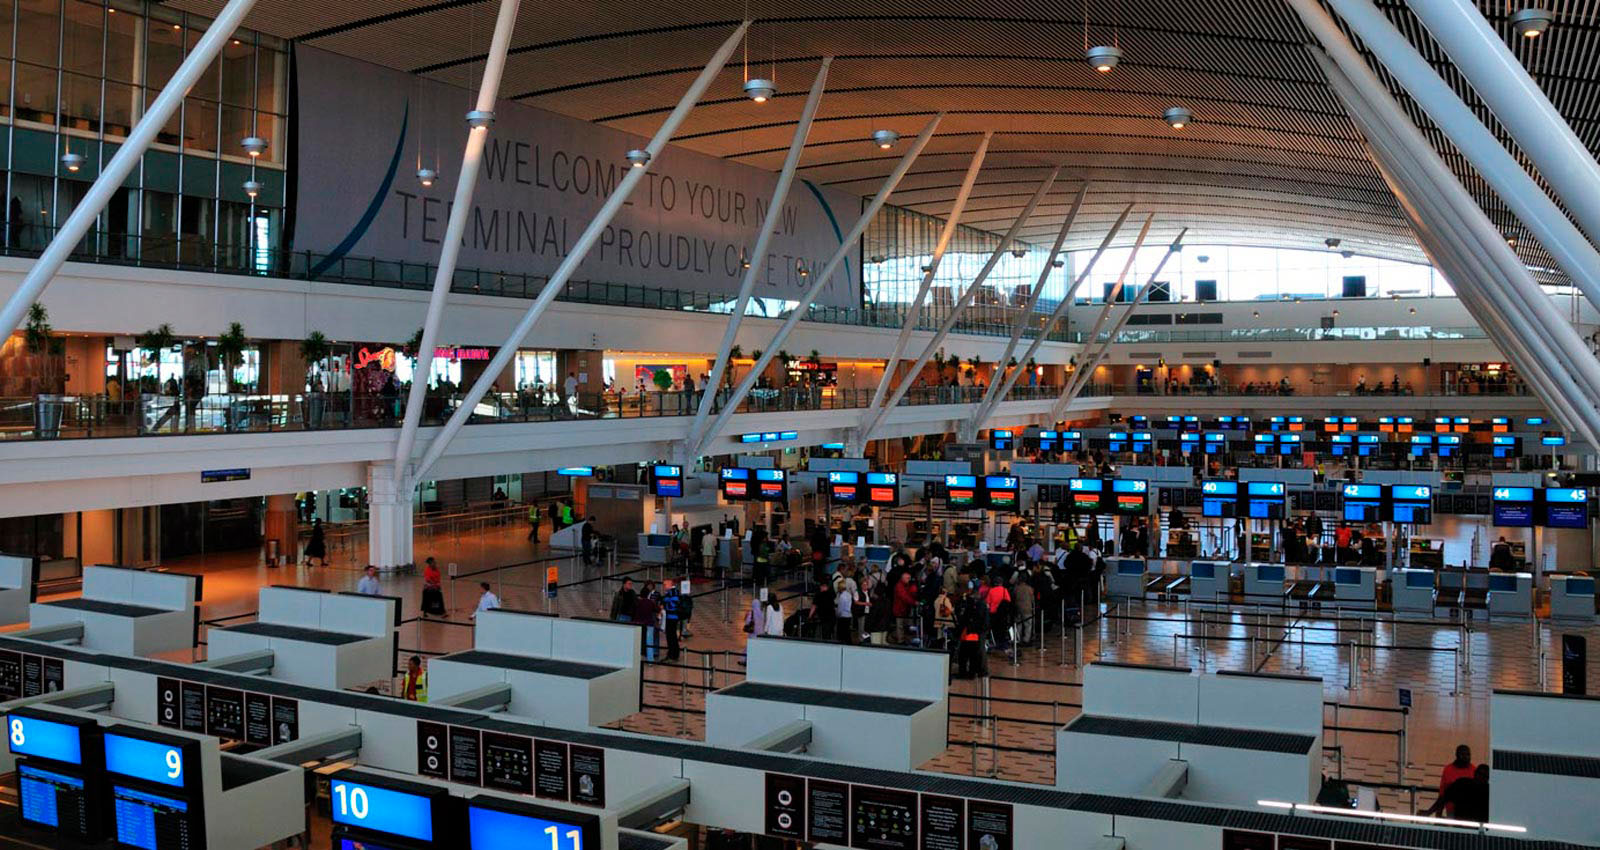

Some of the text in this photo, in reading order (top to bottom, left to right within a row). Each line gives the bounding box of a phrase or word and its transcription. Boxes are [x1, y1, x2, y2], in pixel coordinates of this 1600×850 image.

[645, 171, 676, 212] TO
[686, 180, 747, 226] YOUR
[755, 196, 798, 236] NW
[600, 224, 716, 275] PROUDLY
[670, 466, 680, 475] 31
[722, 468, 733, 478] 32
[773, 470, 784, 480] 33
[829, 472, 841, 482] 34
[884, 473, 896, 484] 35
[946, 475, 958, 485] 36
[1004, 477, 1016, 487] 37
[1070, 479, 1083, 489] 38
[1133, 481, 1146, 491] 39
[1203, 482, 1217, 492] 40
[1270, 483, 1284, 493] 41
[1344, 485, 1358, 496] 42
[1415, 487, 1430, 497] 43
[1494, 488, 1510, 498] 44
[1570, 490, 1585, 500] 45
[11, 718, 26, 746] 8
[165, 749, 181, 779] 9
[333, 783, 370, 820] 10
[543, 825, 580, 850] 11
